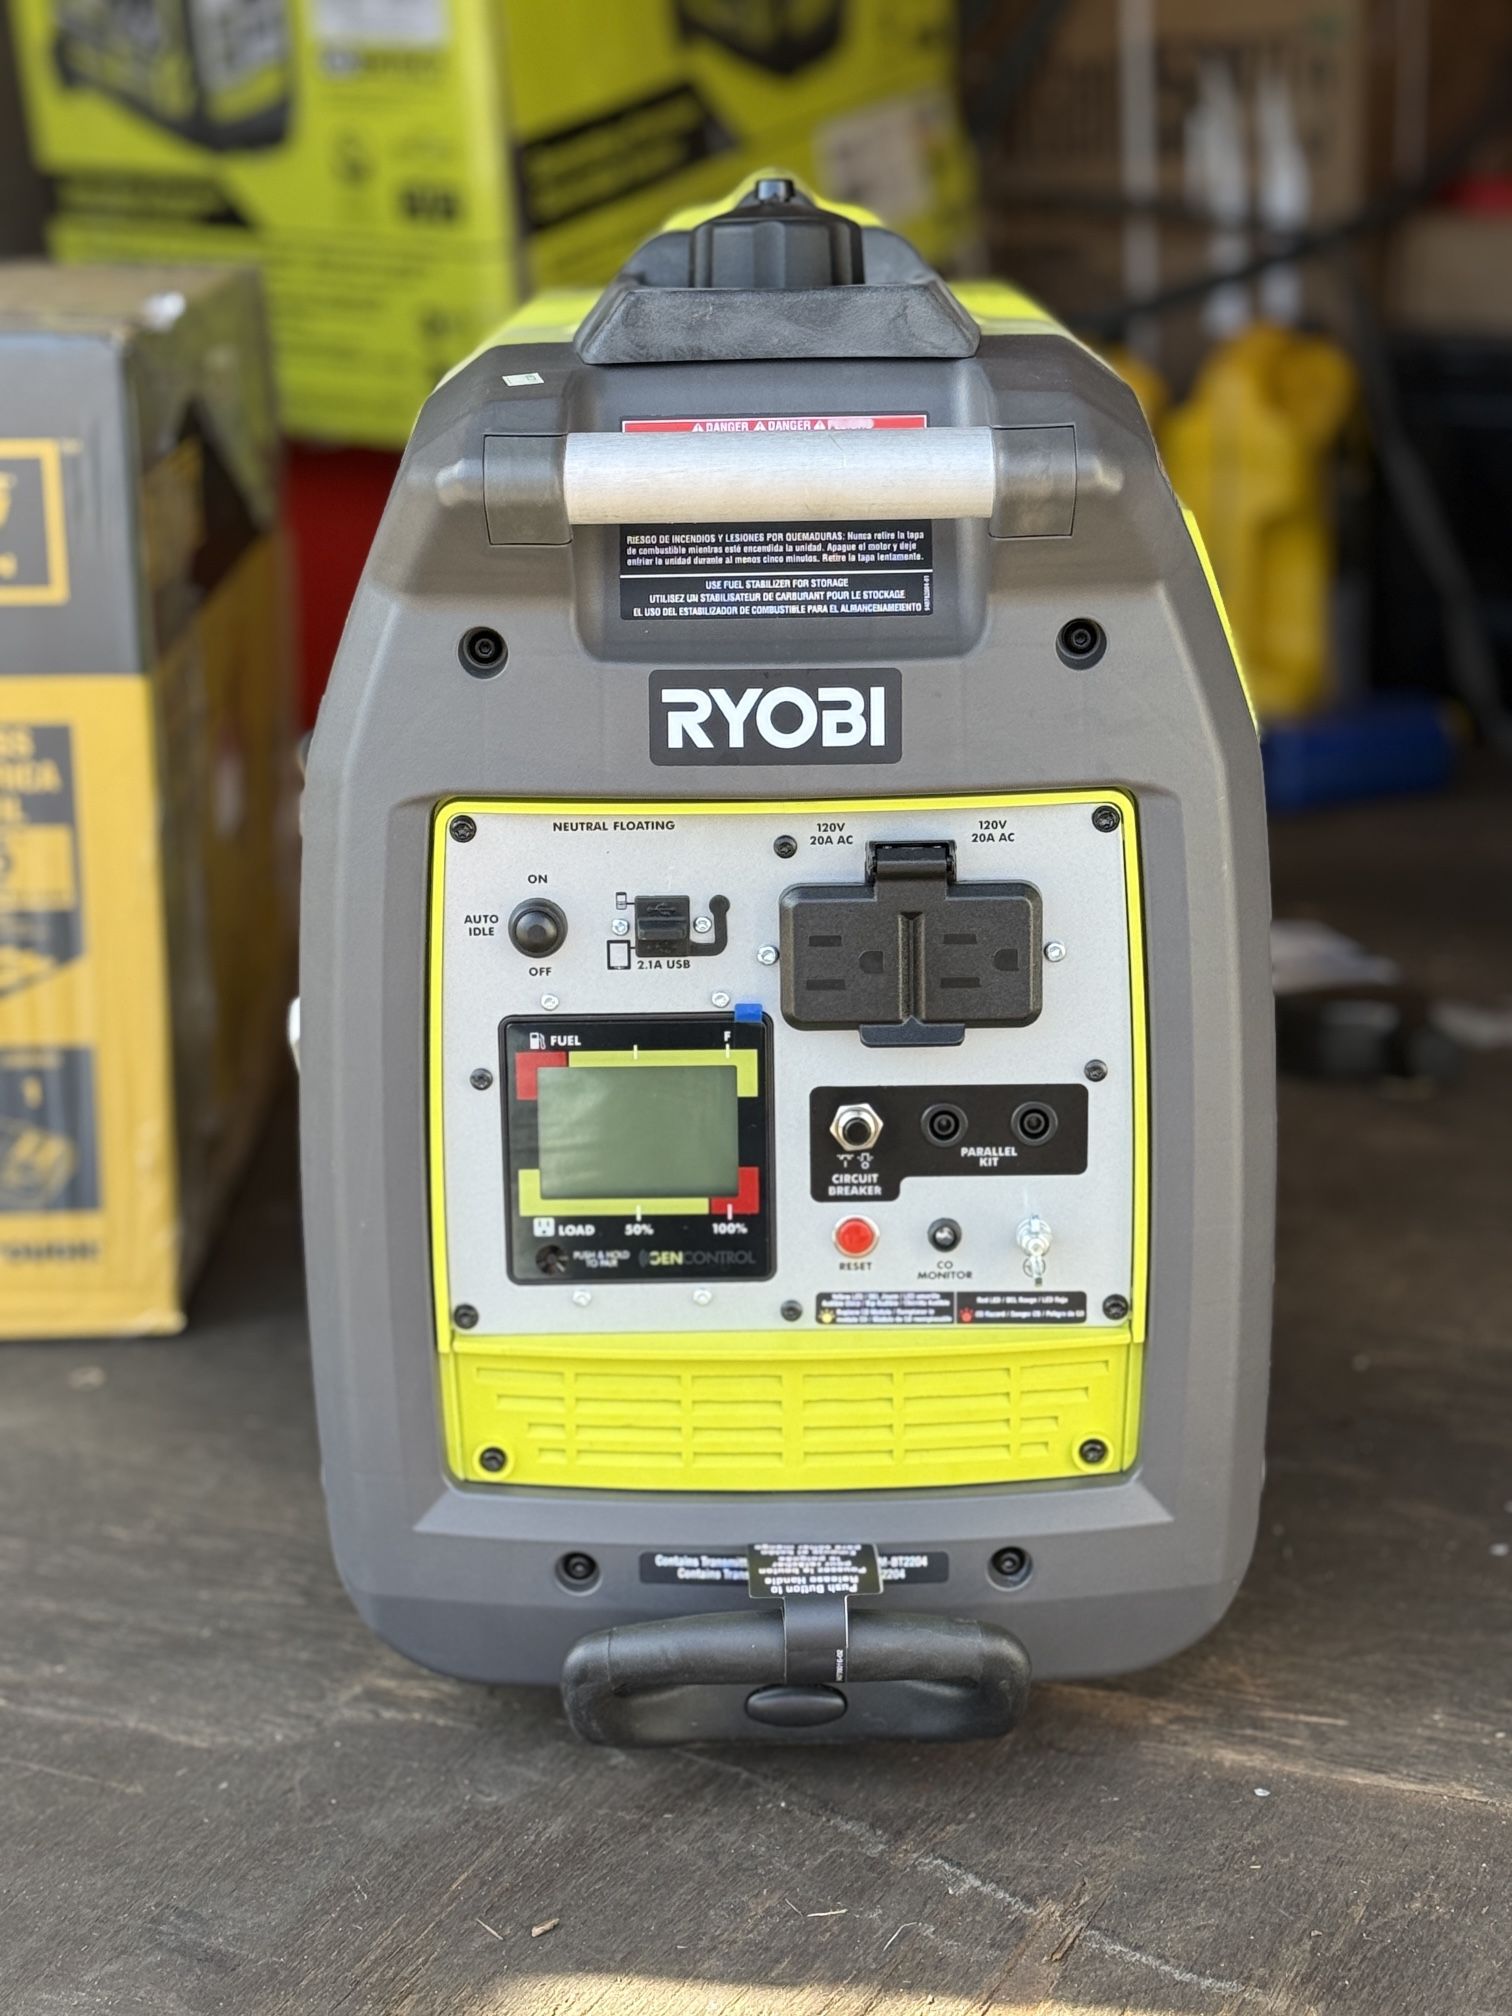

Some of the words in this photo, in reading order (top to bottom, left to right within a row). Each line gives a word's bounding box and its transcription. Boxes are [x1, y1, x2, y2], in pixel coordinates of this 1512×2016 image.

[706, 422, 749, 432] DANGER
[767, 420, 811, 431] DANGER
[626, 535, 657, 544] RIESGO
[659, 535, 670, 544] DE
[672, 534, 716, 544] INCENDIOS
[718, 534, 724, 542] Y
[726, 533, 764, 542] LESIONES
[766, 532, 784, 542] POR
[786, 532, 846, 542] QUEMADURAS:
[848, 531, 872, 540] Nunca
[874, 531, 895, 540] retire
[898, 530, 905, 539] la
[906, 530, 924, 540] tapa
[627, 546, 636, 555] de
[638, 545, 686, 555] combustible
[688, 544, 723, 554] mientras
[743, 544, 784, 553] encendida
[786, 543, 794, 552] la
[795, 543, 825, 552] unidad.
[826, 543, 856, 552] Apague
[858, 542, 866, 551] el
[868, 542, 890, 551] motor
[892, 544, 897, 552] y
[900, 541, 916, 551] deje
[626, 557, 653, 566] enfriar
[655, 557, 662, 566] la
[664, 556, 691, 566] unidad
[693, 556, 723, 565] durante
[725, 556, 732, 564] al
[734, 556, 761, 564] menos
[762, 554, 784, 564] cinco
[786, 554, 820, 563] minutos.
[822, 554, 846, 562] Retire
[848, 554, 856, 562] la
[858, 553, 875, 562] tapa
[877, 552, 924, 562] lentamente.
[706, 580, 722, 590] USE
[724, 580, 744, 589] FUEL
[746, 579, 790, 589] STABILIZER
[792, 578, 809, 588] FOR
[810, 578, 848, 587] STORAGE
[650, 594, 684, 604] UTILISEZ
[686, 593, 698, 603] UN
[700, 592, 761, 602] STABILISATEUR
[763, 592, 774, 601] DE
[776, 591, 824, 601] CARBURANT
[826, 590, 850, 600] POUR
[851, 590, 862, 600] LE
[863, 590, 906, 599] STOCKAGE
[633, 608, 643, 617] EL
[644, 608, 661, 616] USO
[662, 606, 678, 616] DEL
[678, 606, 738, 616] ESTABILIZADOR
[740, 606, 750, 615] DE
[752, 604, 806, 614] COMBUSTIBLE
[808, 604, 828, 613] PARA
[829, 604, 839, 613] EL
[661, 686, 885, 748] RYOBI
[552, 821, 608, 832] NEUTRAL
[613, 820, 676, 832] FLOATING
[816, 822, 846, 832] 120V
[978, 820, 1008, 830] 120V
[810, 836, 834, 846] 20A
[836, 834, 854, 845] AC
[970, 832, 996, 843] 20A
[998, 832, 1015, 842] AC
[528, 874, 548, 884] ON
[464, 914, 499, 924] AUTO
[468, 926, 495, 936] IDLE
[636, 960, 663, 970] 2.1A
[666, 960, 691, 970] USB
[528, 967, 552, 977] OFF
[550, 1036, 582, 1046] FUEL
[724, 1031, 731, 1041] F
[960, 1146, 1018, 1157] PARALLEL
[978, 1157, 1000, 1167] KIT
[832, 1174, 878, 1184] CIRCUIT
[828, 1186, 882, 1196] BREAKER
[558, 1225, 595, 1236] LOAD
[624, 1224, 654, 1236] 50%
[712, 1222, 748, 1234] 100%
[573, 1250, 596, 1260] PUSH
[605, 1250, 630, 1260] HOLD
[650, 1250, 756, 1266] GENCONTROL
[839, 1262, 872, 1271] RESET
[936, 1260, 954, 1270] CO
[917, 1270, 972, 1280] MONITOR
[654, 1554, 700, 1568] Contains
[677, 1567, 722, 1580] Contains
[880, 1568, 906, 1580] 2204
[764, 1577, 806, 1585] Handle
[771, 1586, 783, 1594] to
[786, 1584, 824, 1594] Button
[828, 1584, 858, 1593] Push
